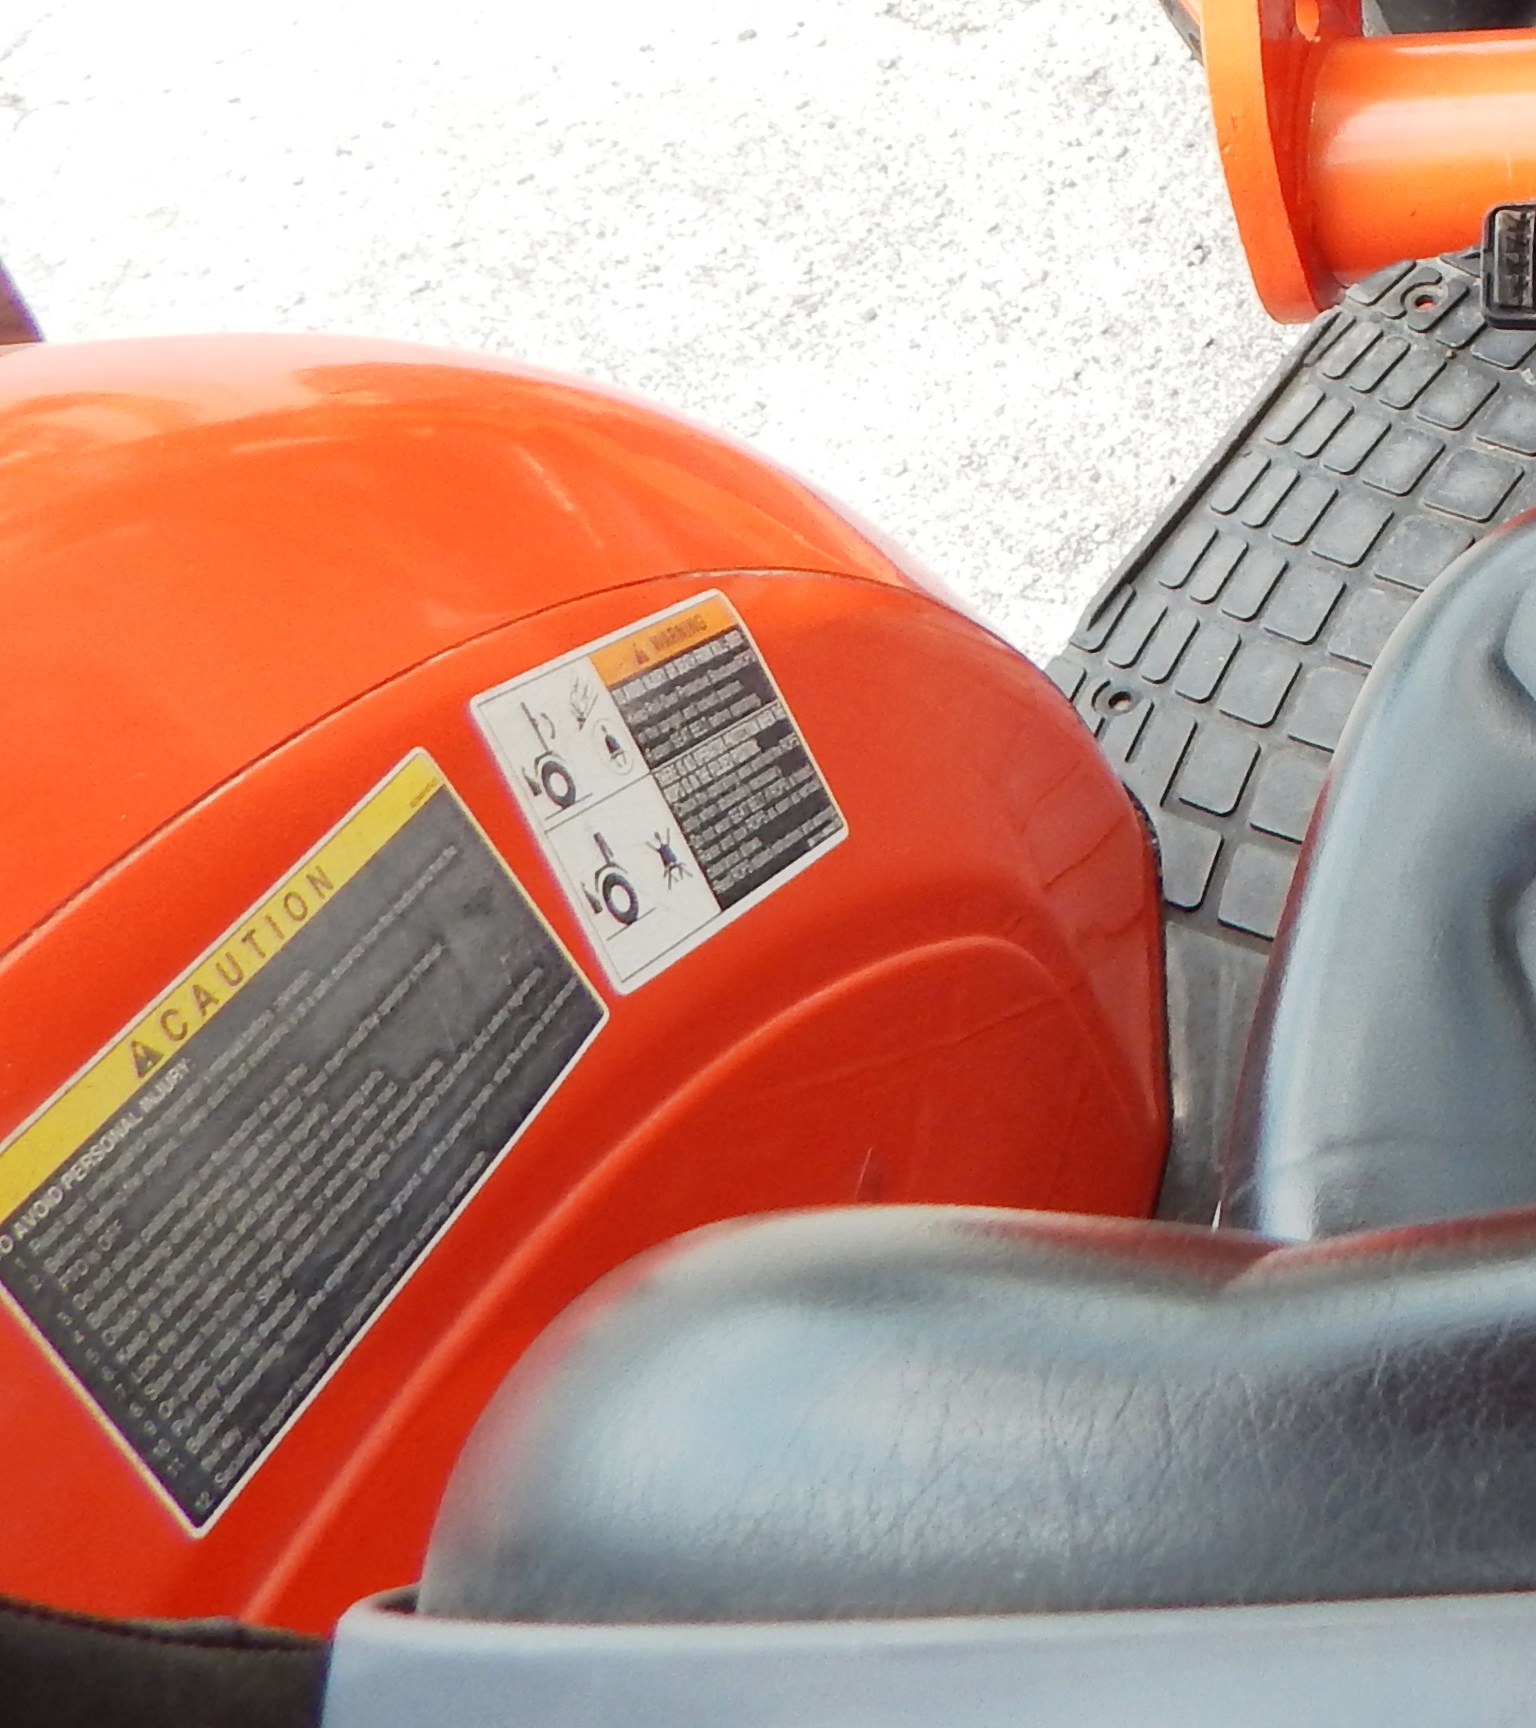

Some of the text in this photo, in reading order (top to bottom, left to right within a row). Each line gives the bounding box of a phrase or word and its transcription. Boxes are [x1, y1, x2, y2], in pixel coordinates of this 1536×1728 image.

[160, 865, 335, 1042] CAUTION
[9, 1180, 67, 1242] AVOID
[57, 1103, 144, 1193] PERSONAL
